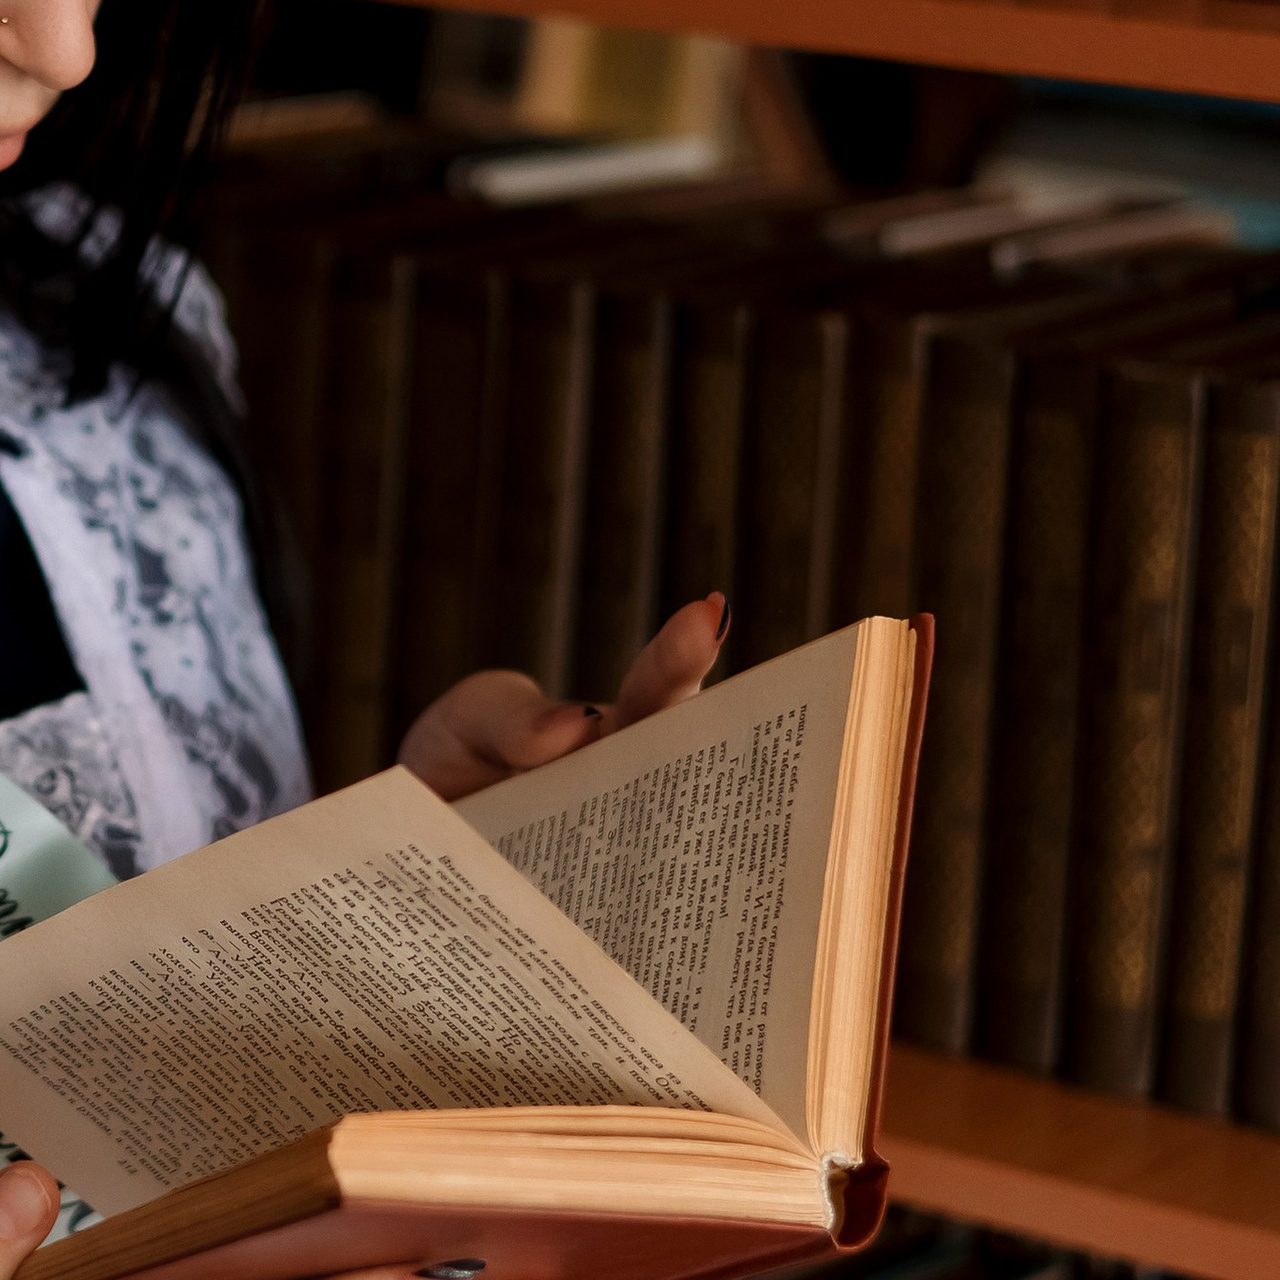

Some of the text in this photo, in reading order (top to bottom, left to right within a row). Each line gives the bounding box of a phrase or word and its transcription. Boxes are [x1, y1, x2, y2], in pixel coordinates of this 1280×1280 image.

[795, 702, 810, 747] пошла
[685, 748, 705, 830] куда-нибудь
[702, 782, 712, 805] как
[703, 744, 717, 778] неть,
[725, 754, 743, 796] Гости
[788, 763, 805, 794] себе
[683, 839, 691, 855] на
[693, 829, 704, 855] уже
[699, 810, 708, 824] ее
[715, 803, 730, 867] утомляли
[719, 772, 752, 918] Вы бы еще посидели!
[773, 811, 793, 874] комнату,
[674, 862, 688, 900] завод
[685, 860, 700, 908] тянуло
[712, 873, 721, 887] ее
[773, 877, 789, 919] чтобы
[240, 910, 324, 986] все бесполезно.
[672, 905, 682, 930] или
[674, 935, 688, 971] дому,
[684, 912, 692, 928] из
[696, 909, 715, 975] стесняли;
[230, 954, 309, 1023] Уйди отсюда!
[248, 929, 288, 964] Вошла
[292, 968, 330, 1003] Алена
[351, 1026, 386, 1058] низко
[257, 903, 434, 1061] скука жизни вселяют сознание
[268, 899, 462, 1074] Громадные пространства, длинные
[298, 887, 491, 1060] сделать так, чтобы дедушка не
[310, 882, 338, 910] жим,
[342, 911, 395, 959] бороться
[407, 972, 433, 994] ней,
[431, 996, 493, 1047] устранить
[493, 1050, 509, 1065] ее,
[320, 877, 551, 1088] ее на слове? Нагрубить ей? Но какая
[331, 872, 545, 1068] ей до тоски, до отвращения... Но что
[343, 868, 584, 1095] чувство. Она негодовала, ненавидела тетю;
[389, 896, 425, 926] груди
[441, 942, 474, 971] Веры
[475, 975, 518, 1013] камнем
[518, 1016, 587, 1083] повернулось
[436, 854, 476, 891] Видно
[476, 892, 508, 924] было,
[513, 927, 537, 945] как
[550, 958, 590, 996] начале
[590, 999, 637, 1043] шестого
[637, 1046, 665, 1069] часа
[664, 1072, 682, 1085] из
[681, 1088, 715, 1114] дома
[759, 924, 780, 995] отдохнуть
[87, 980, 140, 1025] коридору
[151, 1036, 188, 1066] топоча
[128, 959, 279, 1098] нила на ковер золотые часы.
[157, 946, 324, 1098] лодея; никогда раньше она не
[179, 936, 201, 954] что
[205, 959, 239, 987] хотят
[243, 993, 259, 1005] от
[264, 1012, 284, 1032] нее,
[303, 1050, 334, 1078] стала
[207, 946, 246, 979] Алена
[247, 985, 316, 1047] растерялась
[334, 1068, 349, 1080] от
[219, 919, 410, 1097] выносить кресла, чтобы выбить из
[249, 906, 272, 925] ние
[271, 926, 320, 968] кажется
[319, 968, 396, 1041] безнадежным,
[409, 1053, 448, 1087] ничего
[447, 1090, 462, 1102] не
[276, 896, 501, 1096] рой конца не видно, убить одну мышь
[671, 991, 679, 1014] она
[688, 1016, 697, 1033] то
[760, 1001, 768, 1016] от
[156, 969, 314, 1121] Алена издала какой-то стон,
